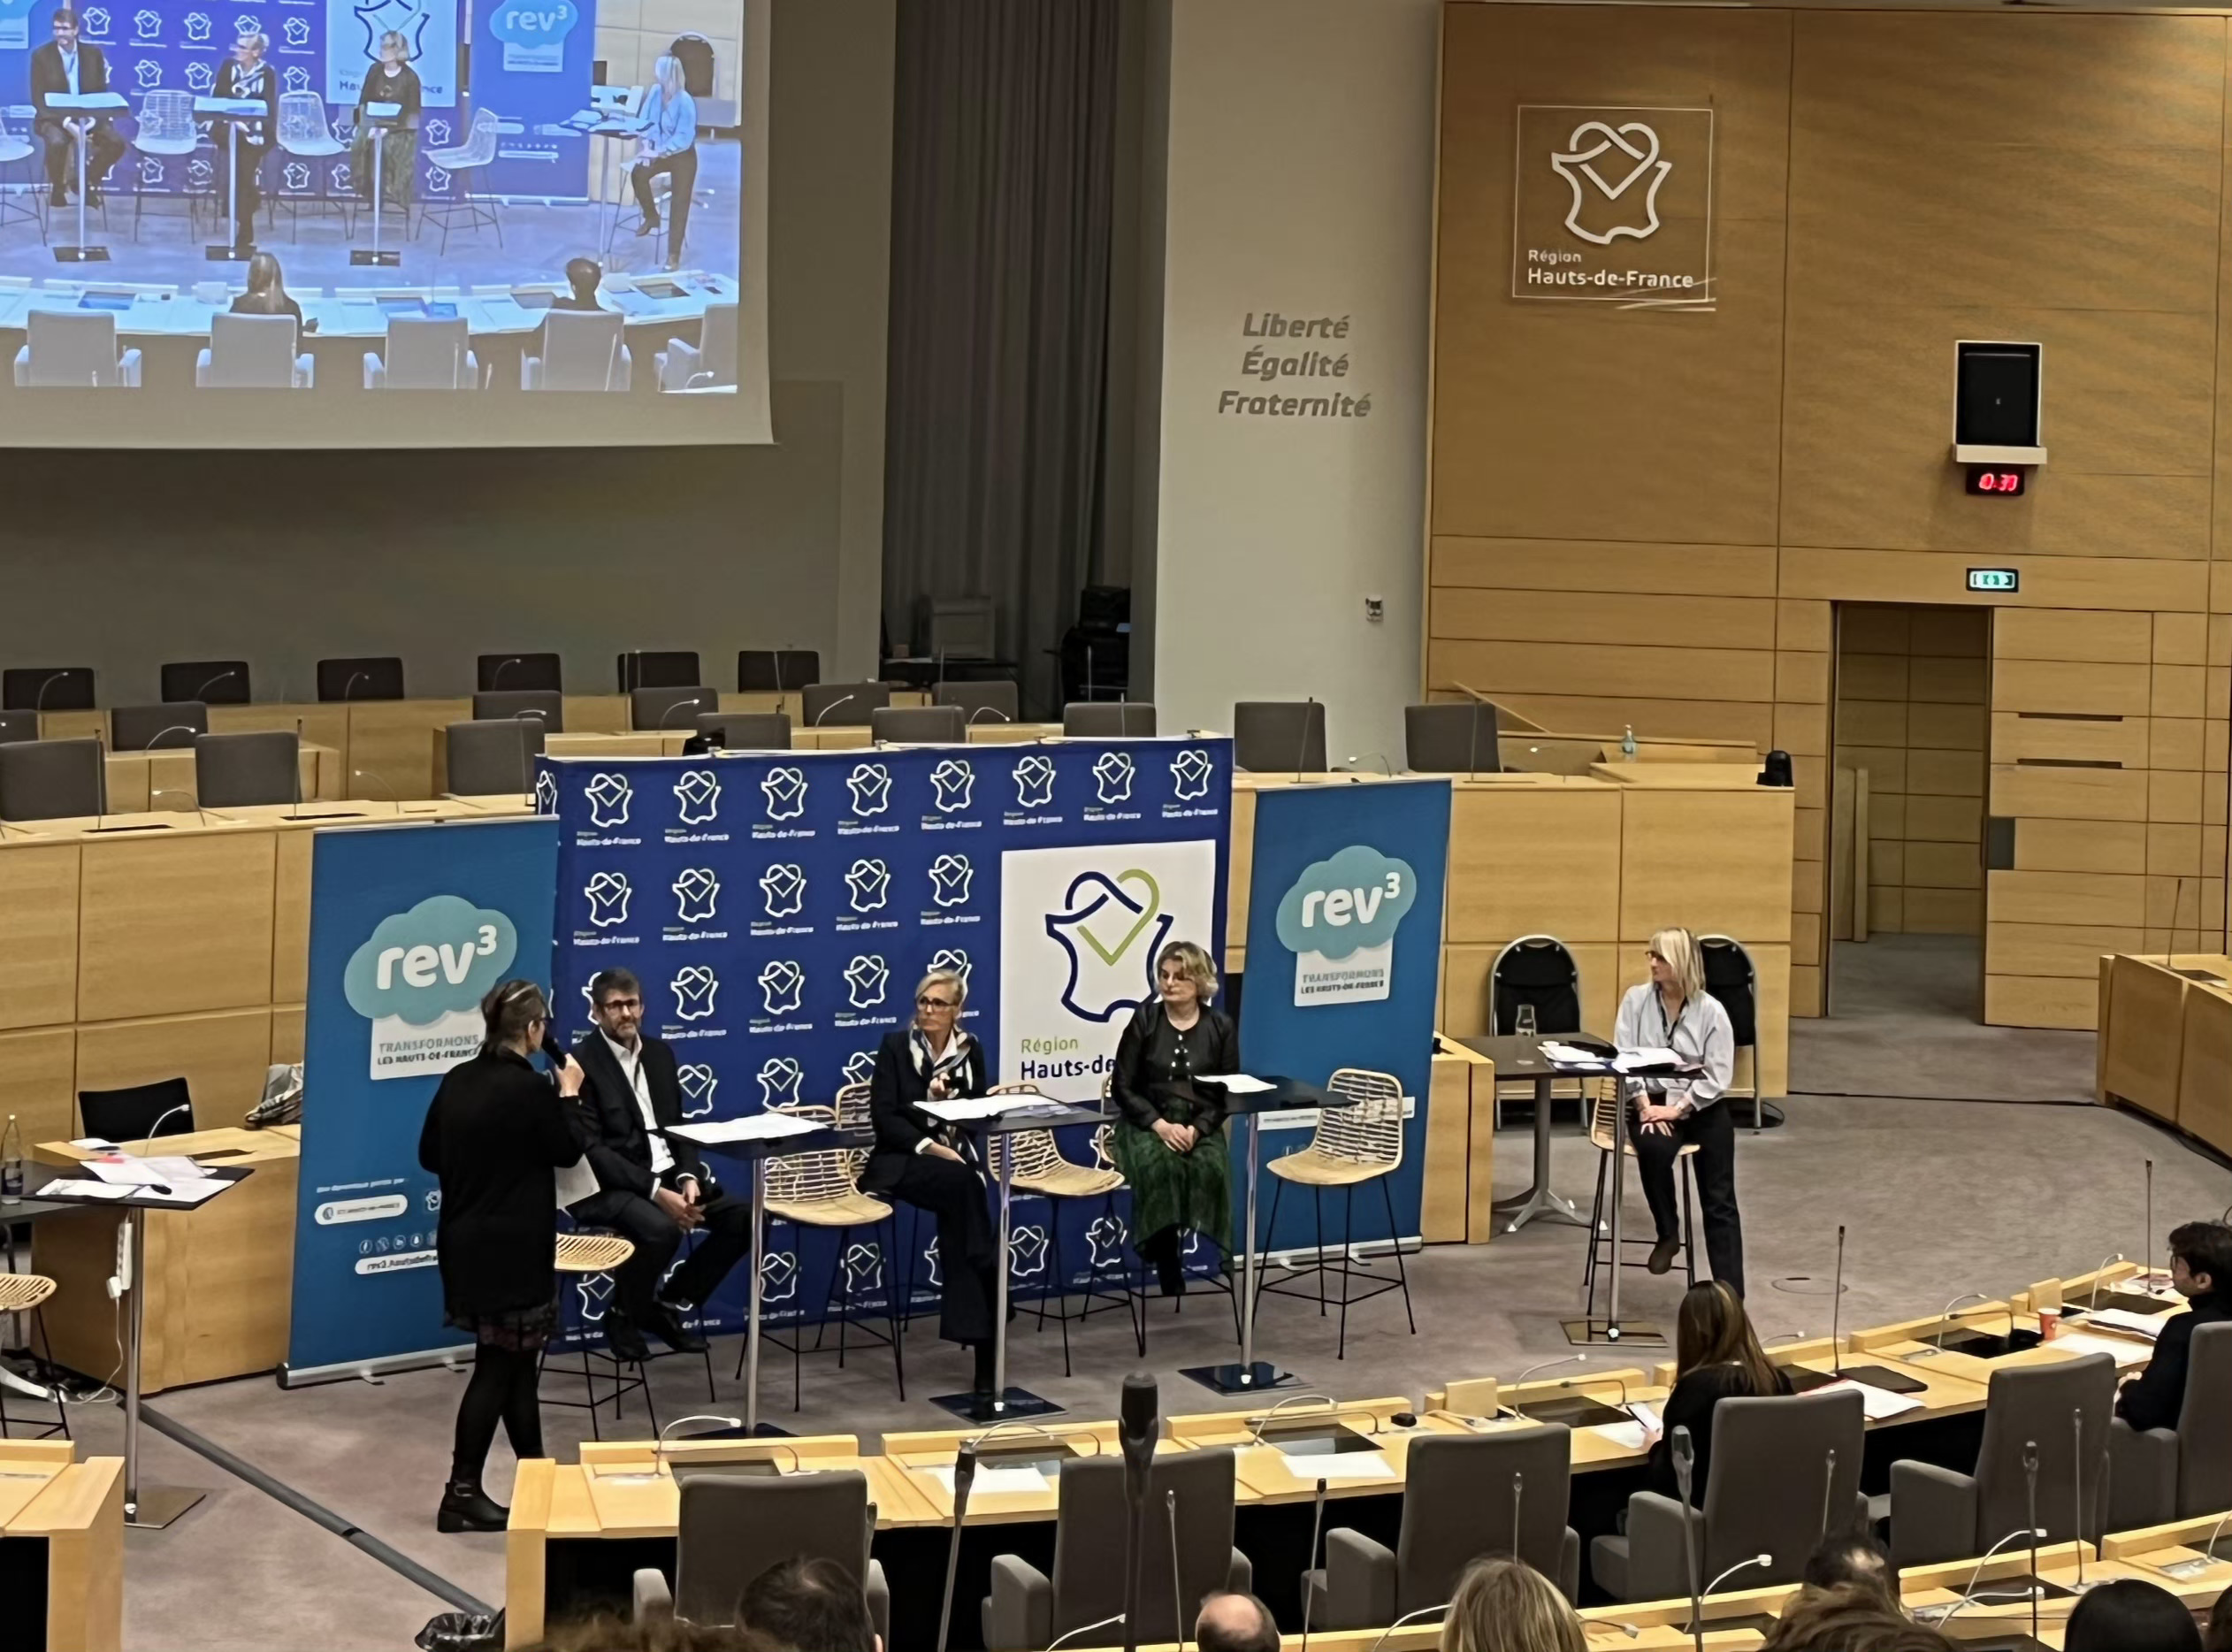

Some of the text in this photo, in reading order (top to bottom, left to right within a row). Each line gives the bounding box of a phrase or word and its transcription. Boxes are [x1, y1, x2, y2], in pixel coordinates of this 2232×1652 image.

[1528, 249, 1582, 265] Région
[1527, 267, 1694, 288] Hauts-de-France
[1242, 312, 1350, 339] Liberté
[1242, 344, 1349, 381] Égalité
[1219, 390, 1372, 417] Fraternité
[1021, 1036, 1079, 1055] Région
[1020, 1054, 1115, 1081] Hauts-de
